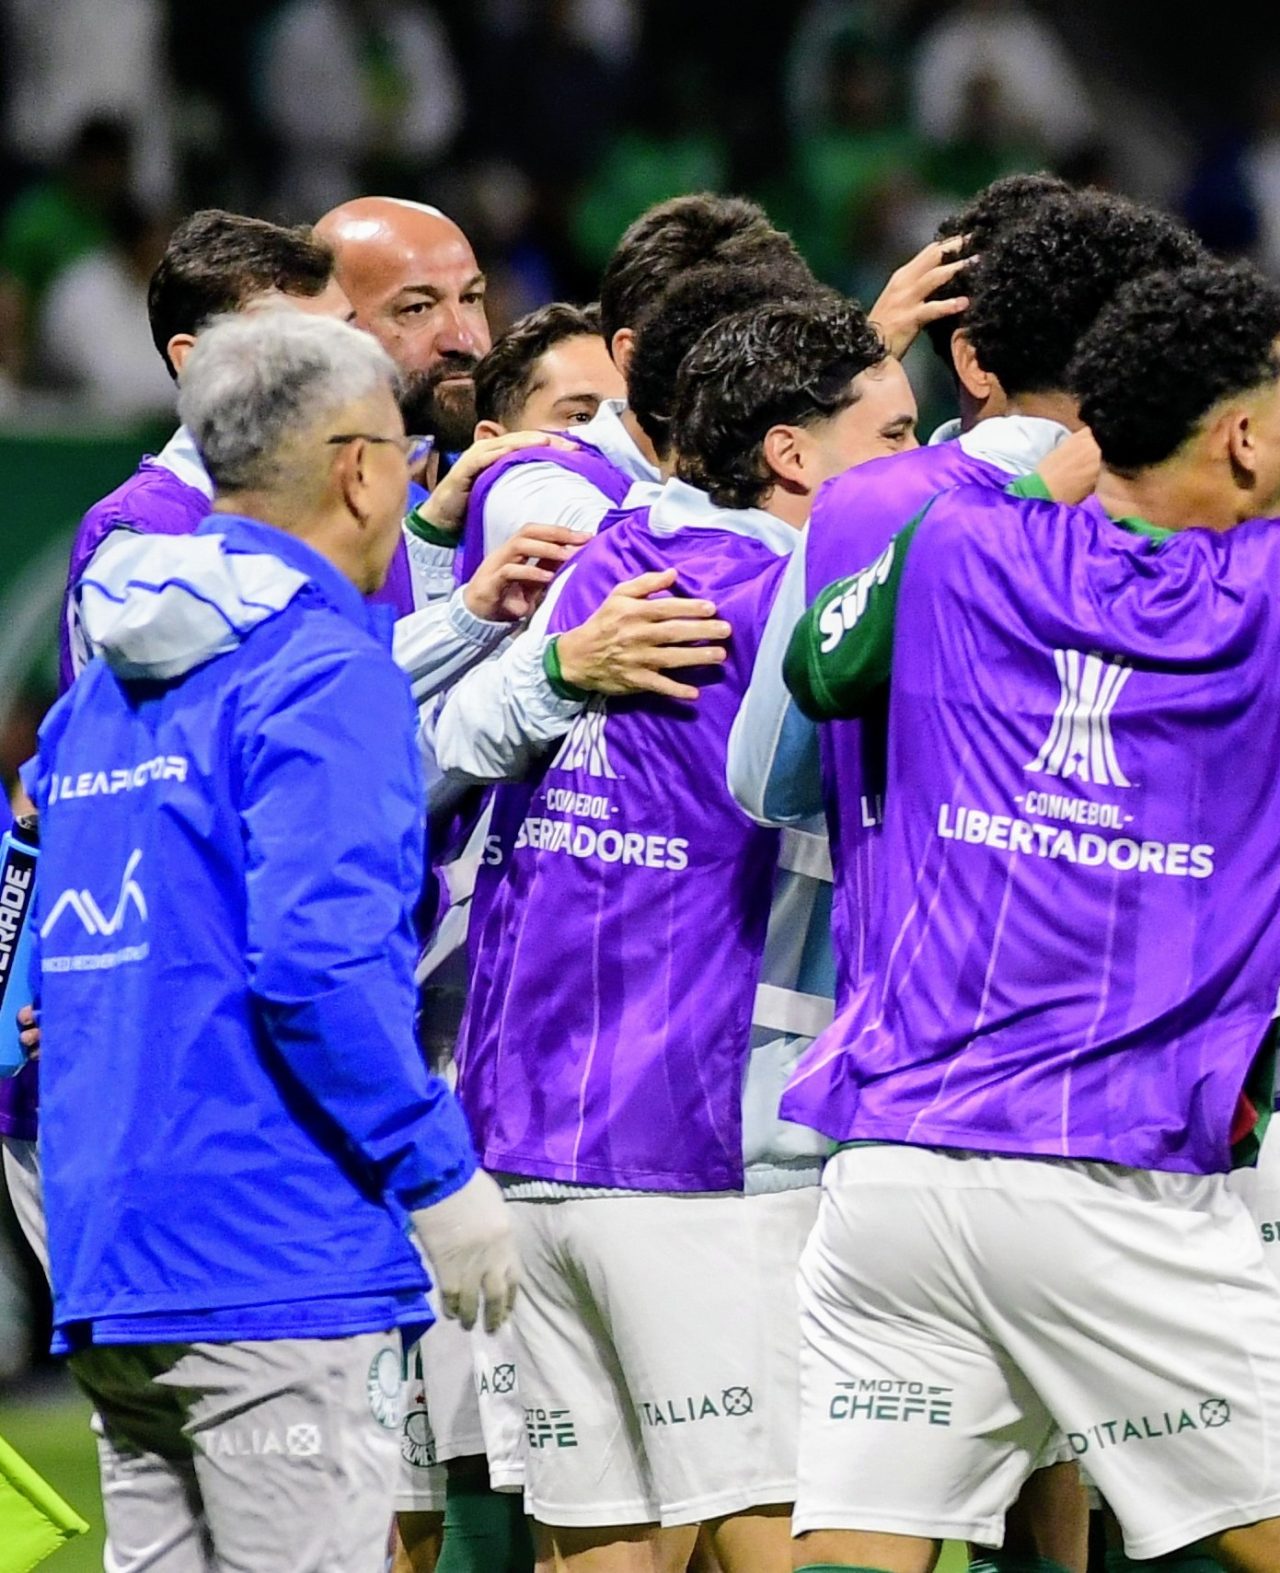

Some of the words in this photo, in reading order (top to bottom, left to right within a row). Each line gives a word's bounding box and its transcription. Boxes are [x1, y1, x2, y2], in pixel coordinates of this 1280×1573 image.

[1024, 790, 1124, 830] CONMEBOL
[937, 802, 1216, 879] LIBERTADORES
[0, 864, 33, 984] ERADE
[858, 1379, 924, 1395] MOTO
[829, 1394, 952, 1427] CHEFE
